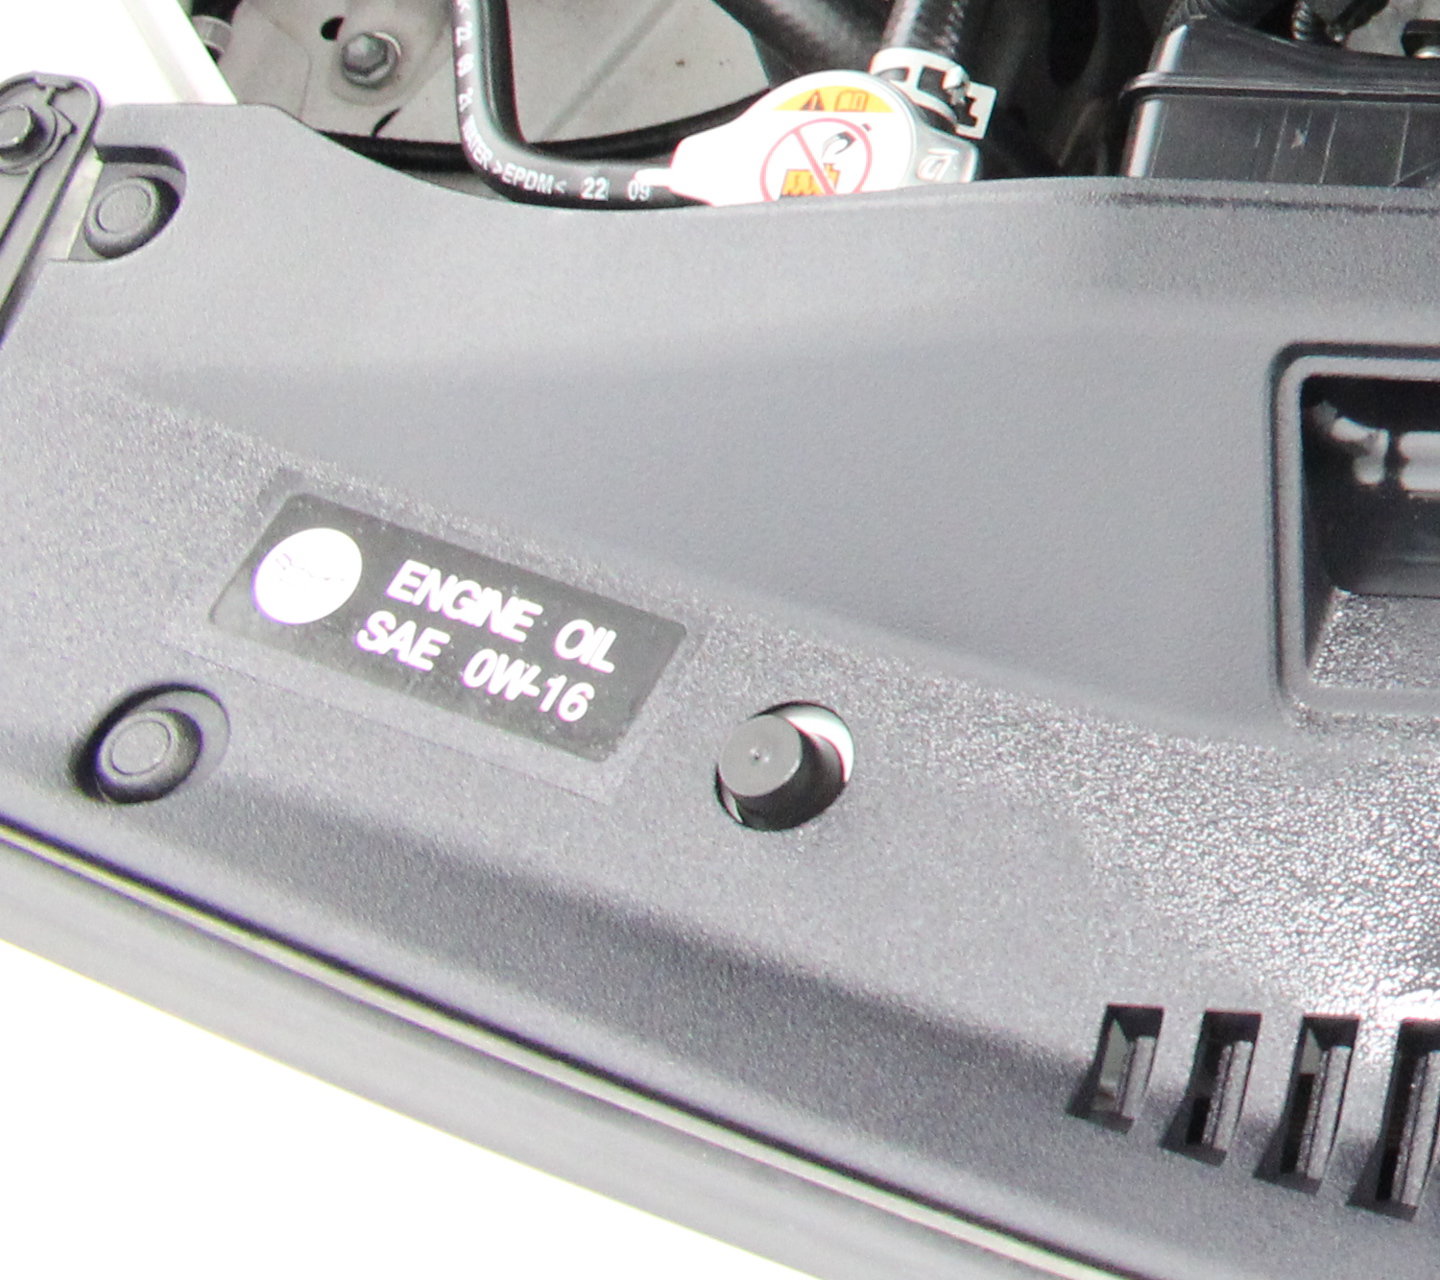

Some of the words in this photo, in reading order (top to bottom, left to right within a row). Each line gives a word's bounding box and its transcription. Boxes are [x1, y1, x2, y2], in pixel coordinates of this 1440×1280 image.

[577, 171, 612, 206] 22
[623, 177, 652, 205] 09
[355, 610, 451, 671] SAE
[462, 649, 596, 722] 0W-16
[386, 559, 544, 643] ENGINE
[554, 619, 617, 674] OIL
